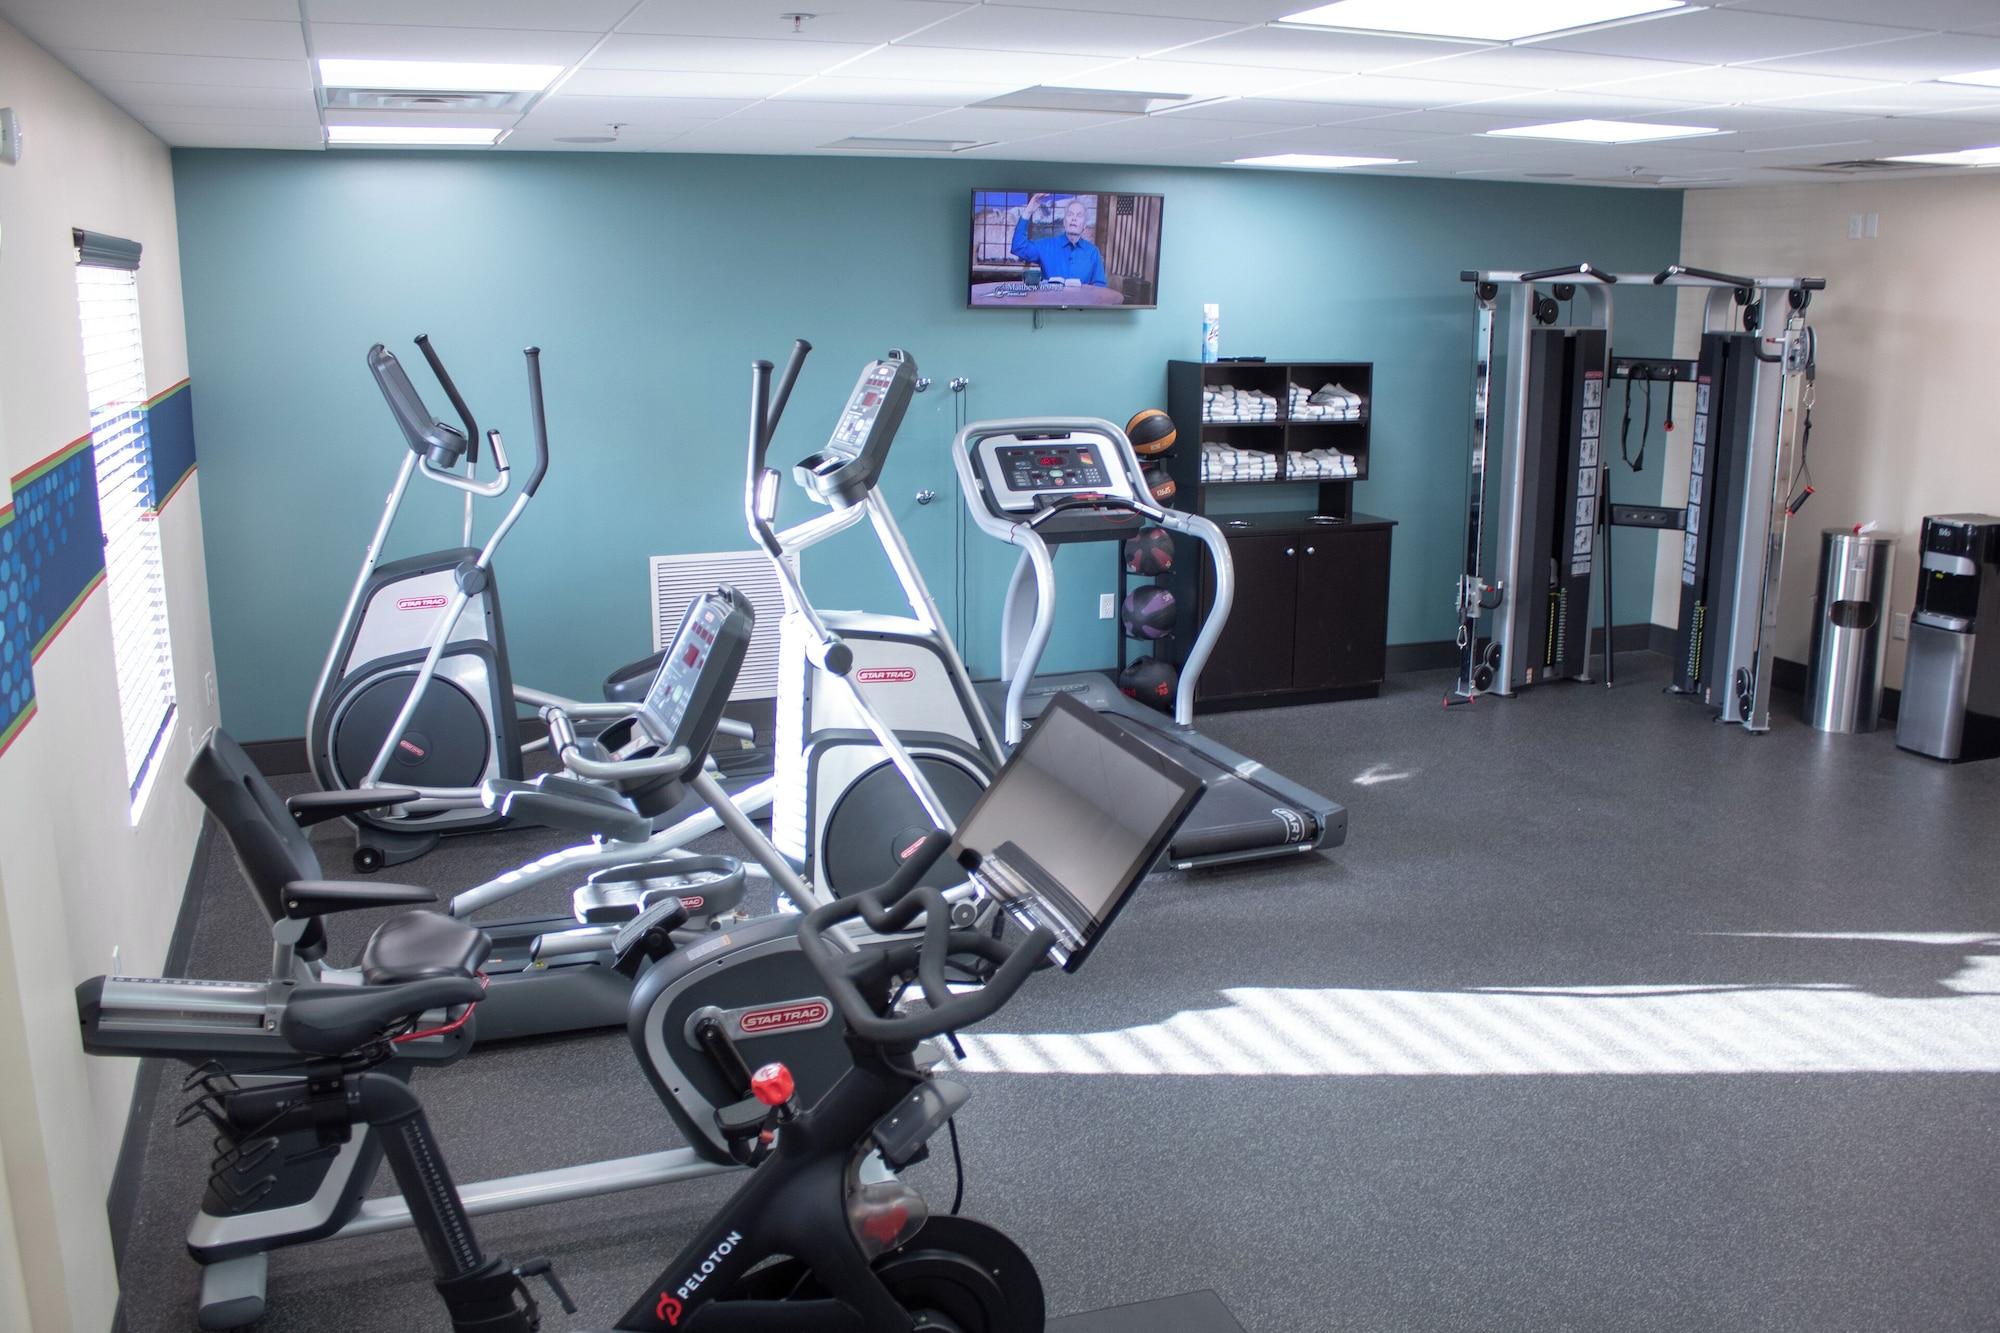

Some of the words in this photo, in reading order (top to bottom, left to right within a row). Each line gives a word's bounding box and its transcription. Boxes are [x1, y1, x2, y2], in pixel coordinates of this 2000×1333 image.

[1007, 283, 1038, 292] Matthew
[422, 598, 446, 606] TRAC
[744, 1014, 782, 1027] STAR
[783, 1008, 821, 1021] TRAC
[677, 1230, 743, 1300] PELOTON
